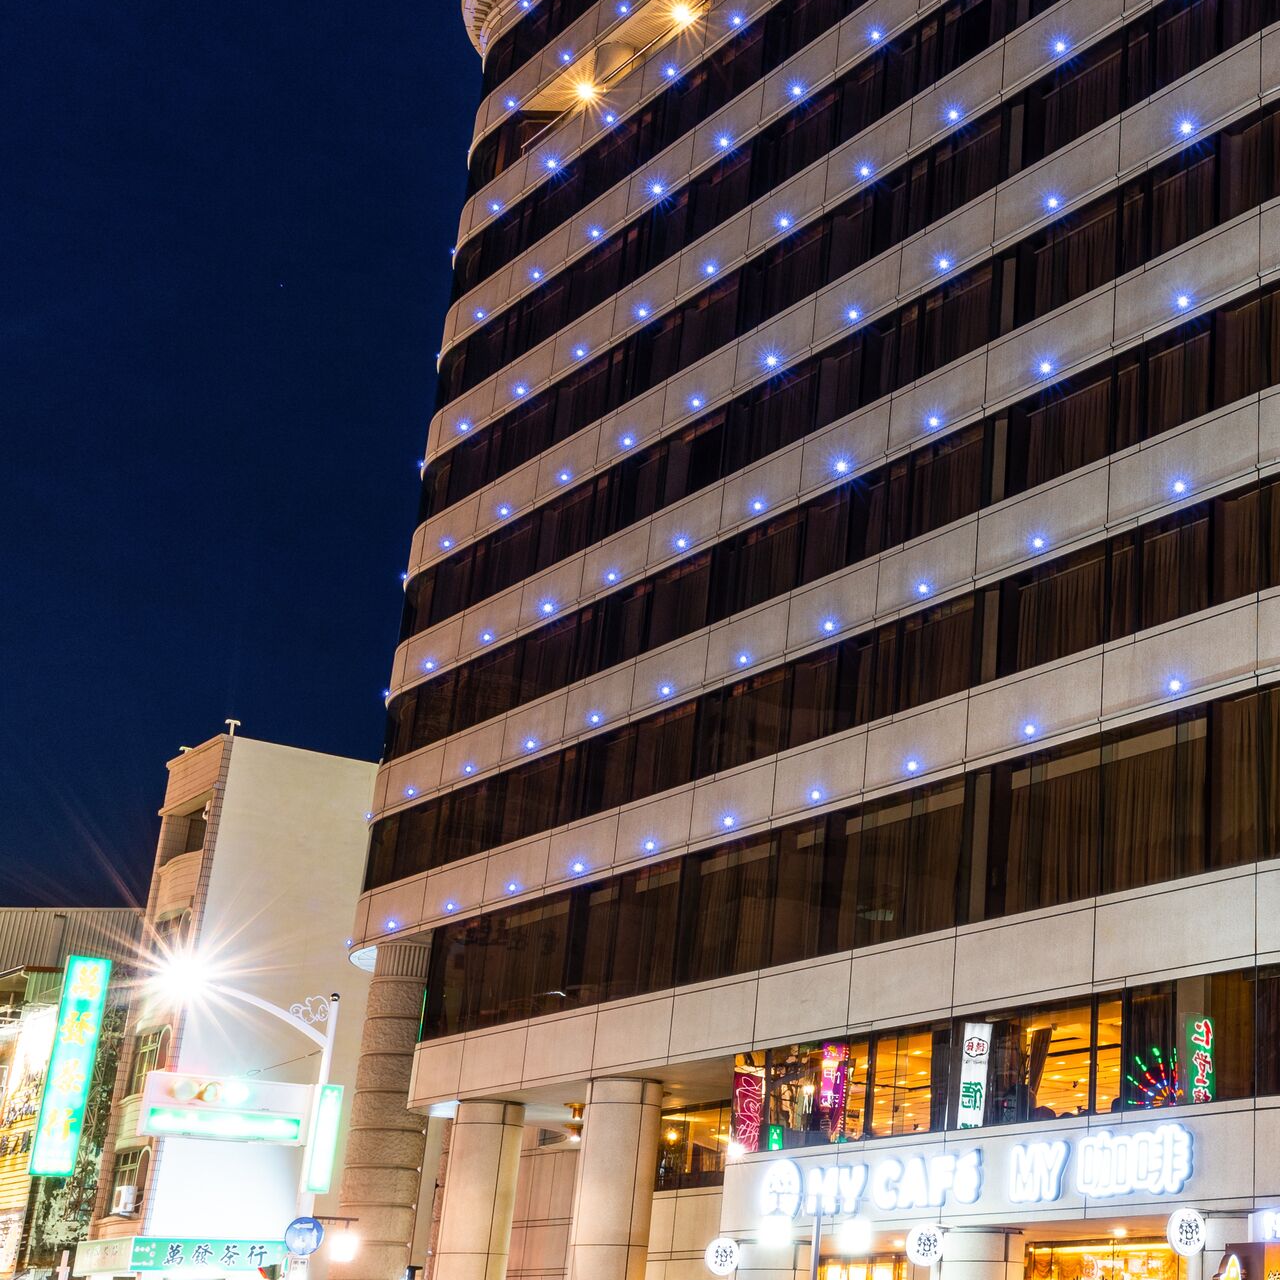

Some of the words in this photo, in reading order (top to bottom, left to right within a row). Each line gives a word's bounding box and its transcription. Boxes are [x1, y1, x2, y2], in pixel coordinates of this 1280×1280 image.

[1009, 1140, 1071, 1203] MY
[1077, 1124, 1195, 1198] 咖啡
[806, 1165, 870, 1216] MY
[163, 1243, 268, 1267] 萬發茶行
